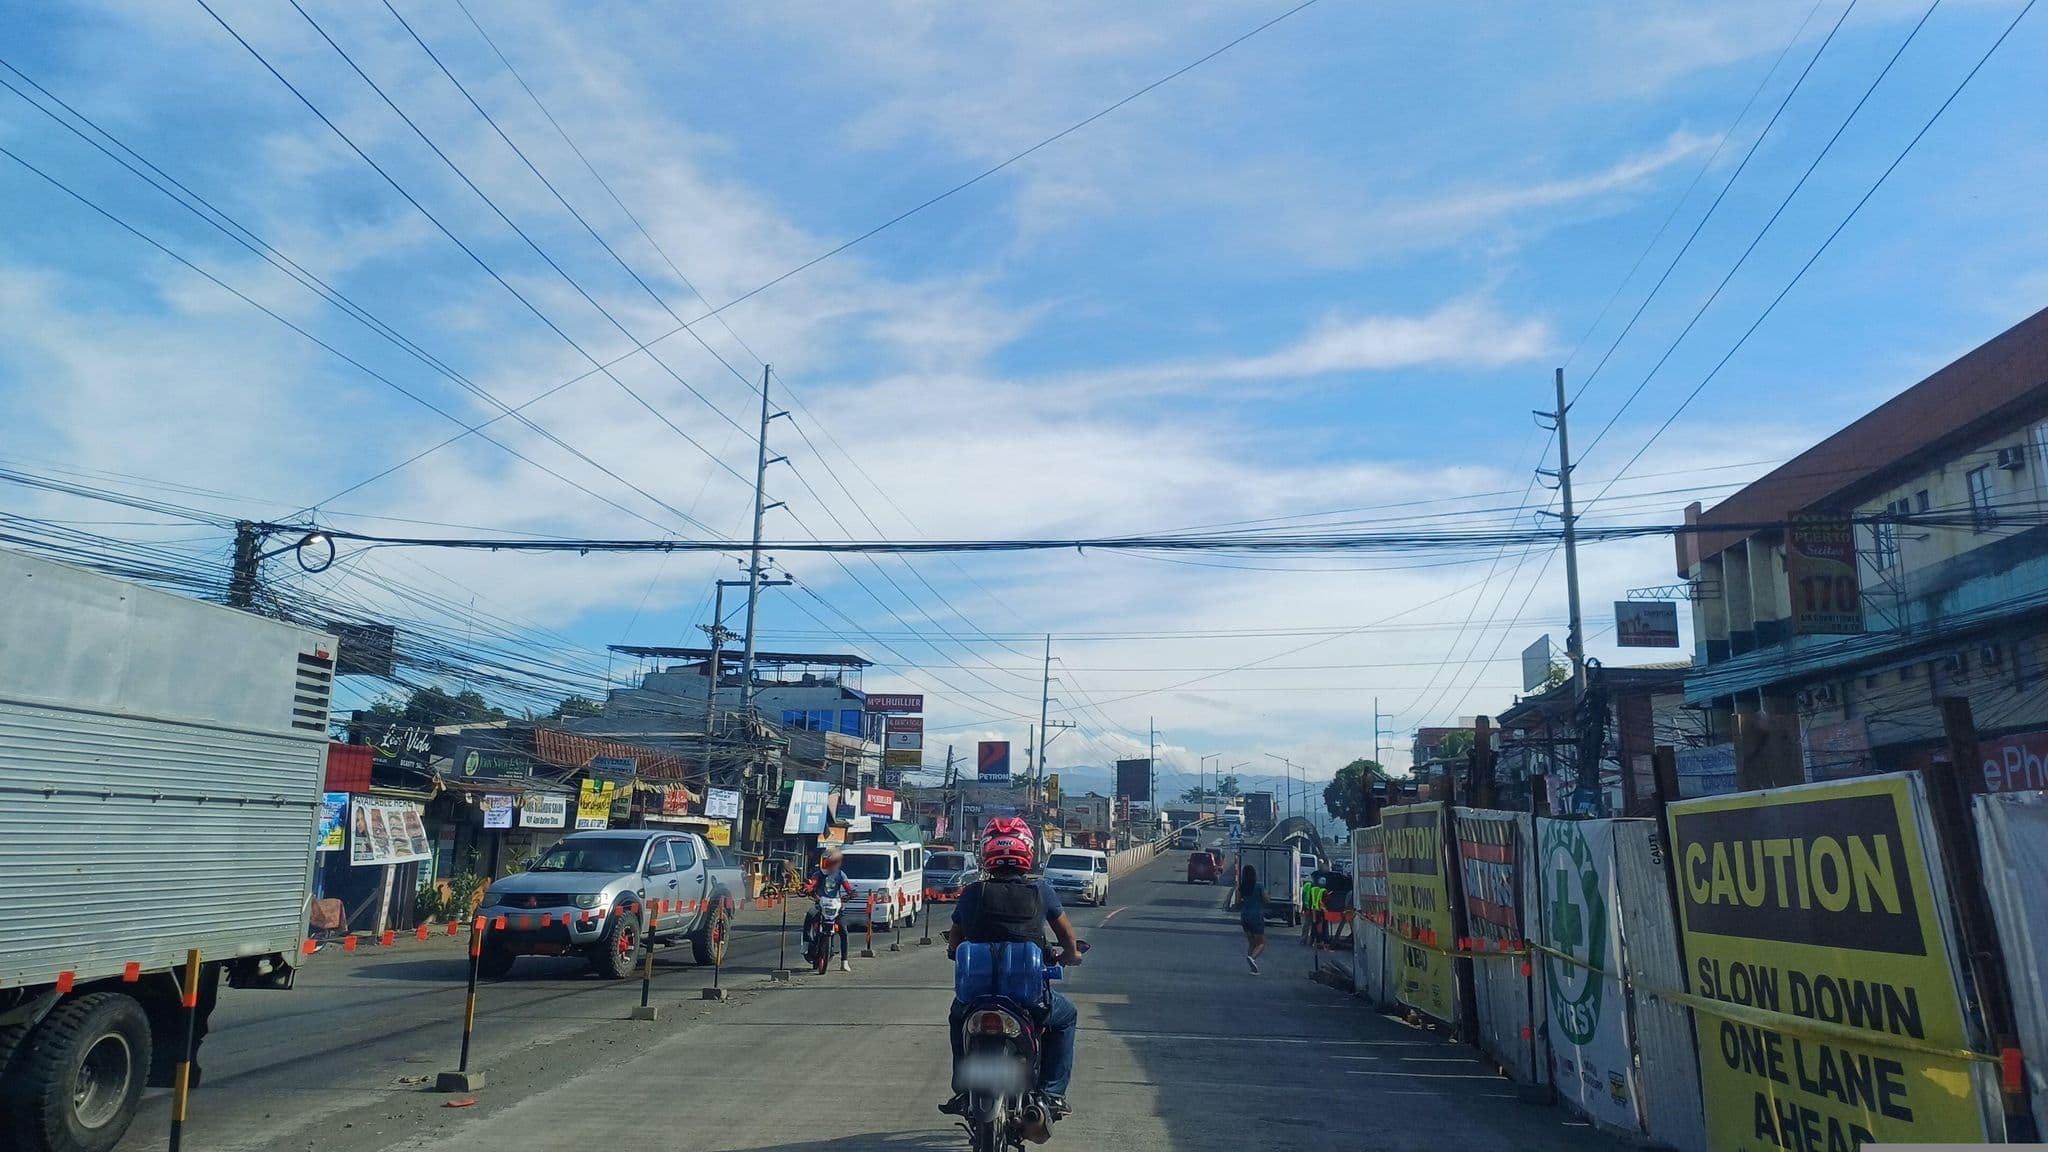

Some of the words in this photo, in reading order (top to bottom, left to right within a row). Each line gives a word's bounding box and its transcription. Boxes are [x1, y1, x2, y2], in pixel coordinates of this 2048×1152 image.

[1385, 826, 1435, 860] CAUTION
[1685, 833, 1903, 915] CAUTION
[1556, 992, 1598, 1035] FIRST
[1697, 956, 1779, 1014] SLOW
[1788, 969, 1926, 1041] DOWN
[1719, 1020, 1790, 1086] ONE
[1793, 1037, 1915, 1124] LANE
